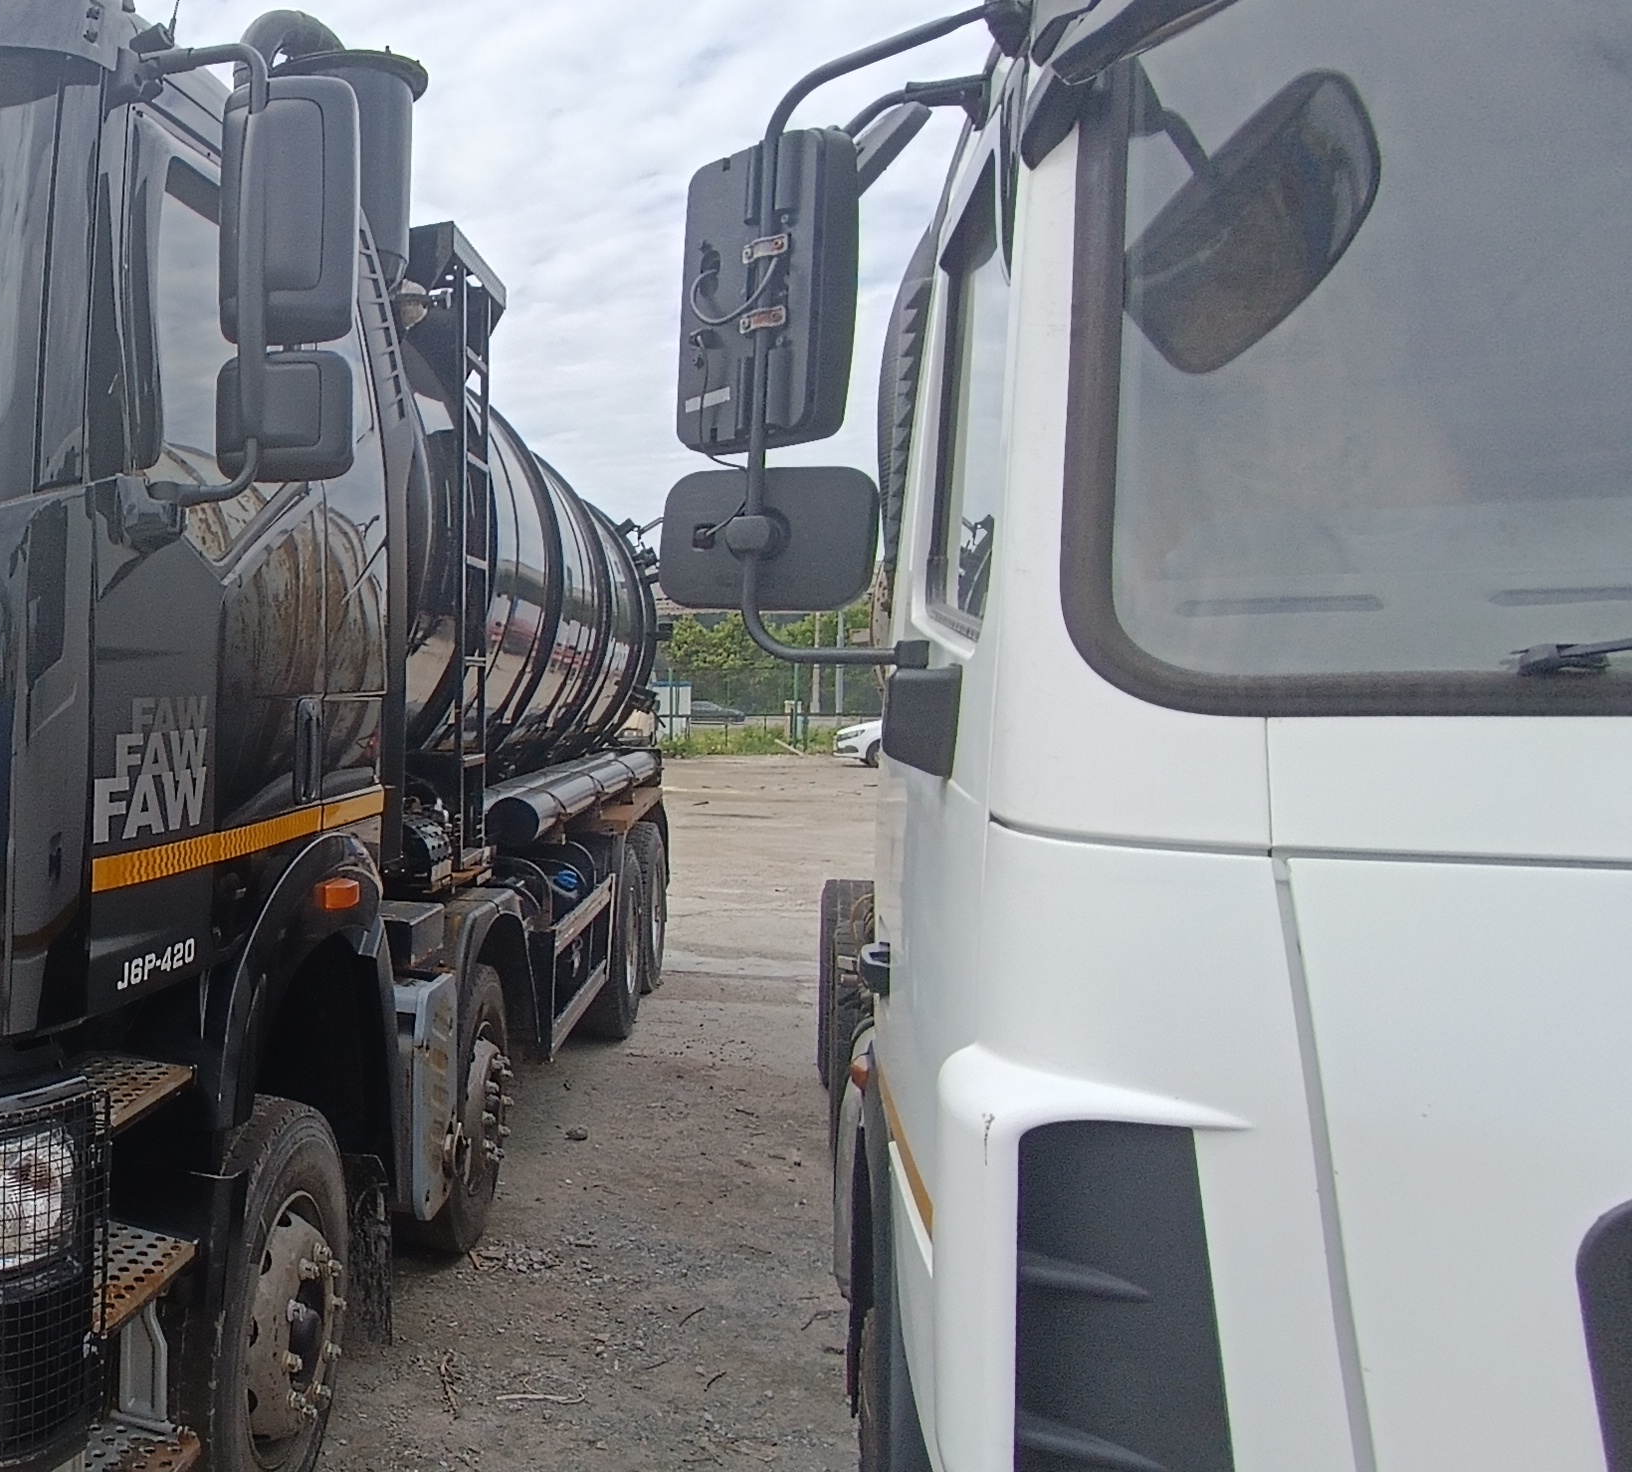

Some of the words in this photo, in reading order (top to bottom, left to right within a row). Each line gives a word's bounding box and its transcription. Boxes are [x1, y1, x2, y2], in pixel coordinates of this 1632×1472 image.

[131, 696, 207, 734] FAW
[116, 729, 207, 779] FAW
[93, 766, 207, 844] FAW
[117, 938, 195, 990] J6P-420
